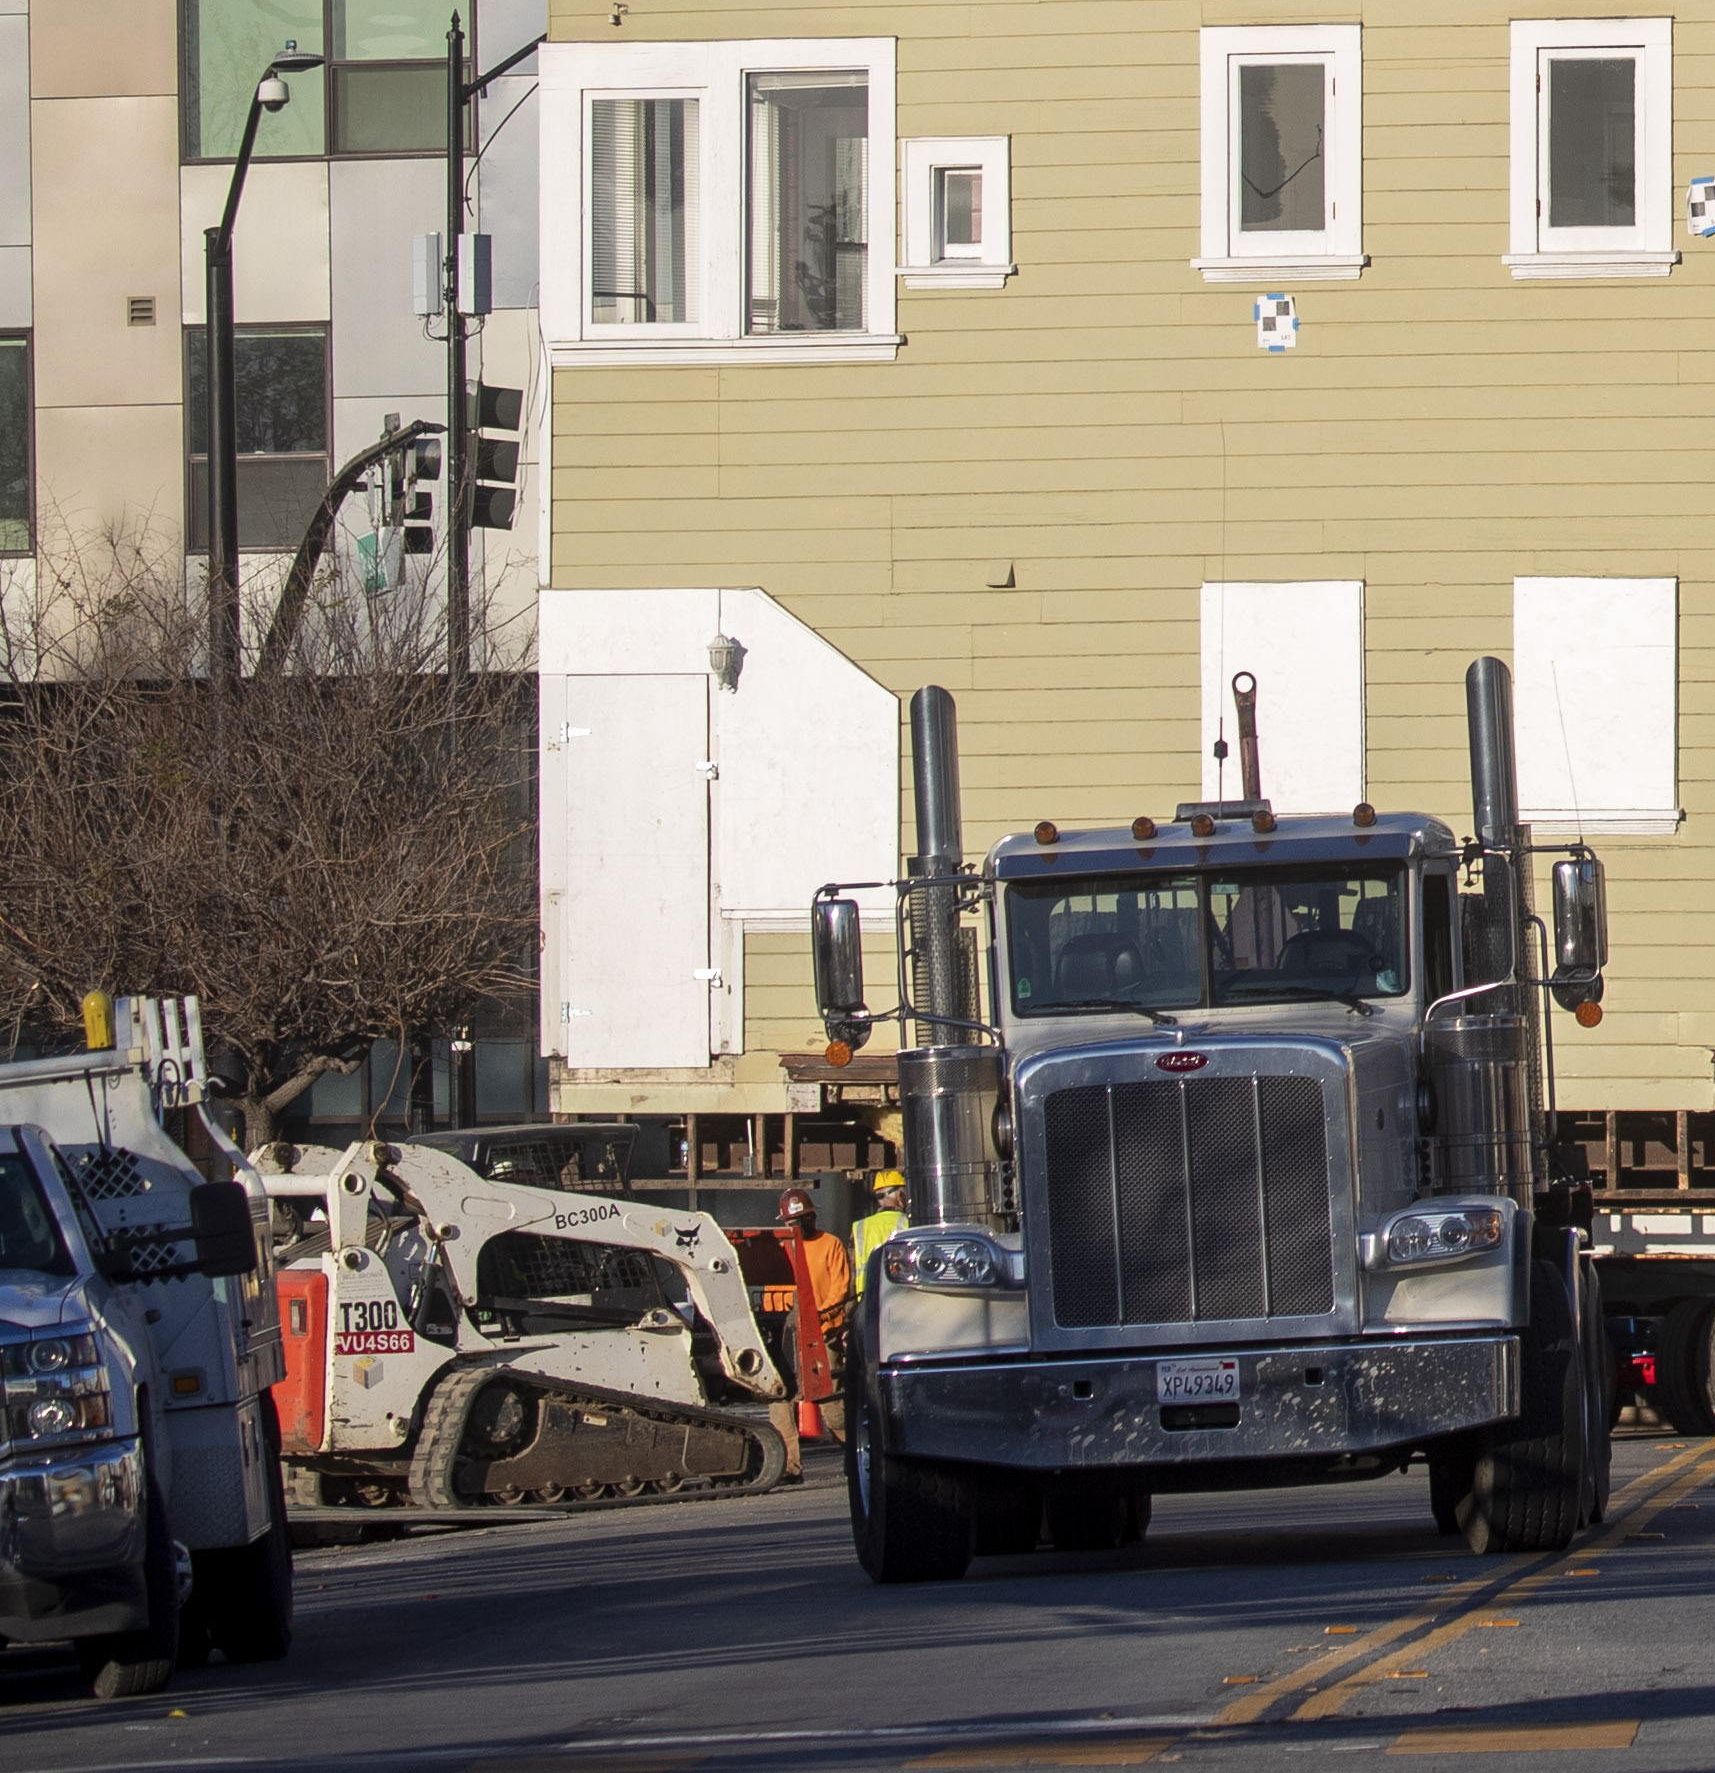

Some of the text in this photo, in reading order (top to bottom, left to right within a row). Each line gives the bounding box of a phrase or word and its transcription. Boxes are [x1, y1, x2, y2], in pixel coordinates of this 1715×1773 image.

[555, 1203, 621, 1230] BC300A
[340, 1300, 398, 1332] T300
[340, 1333, 410, 1352] VU4S66
[1163, 1373, 1234, 1400] XP49349
